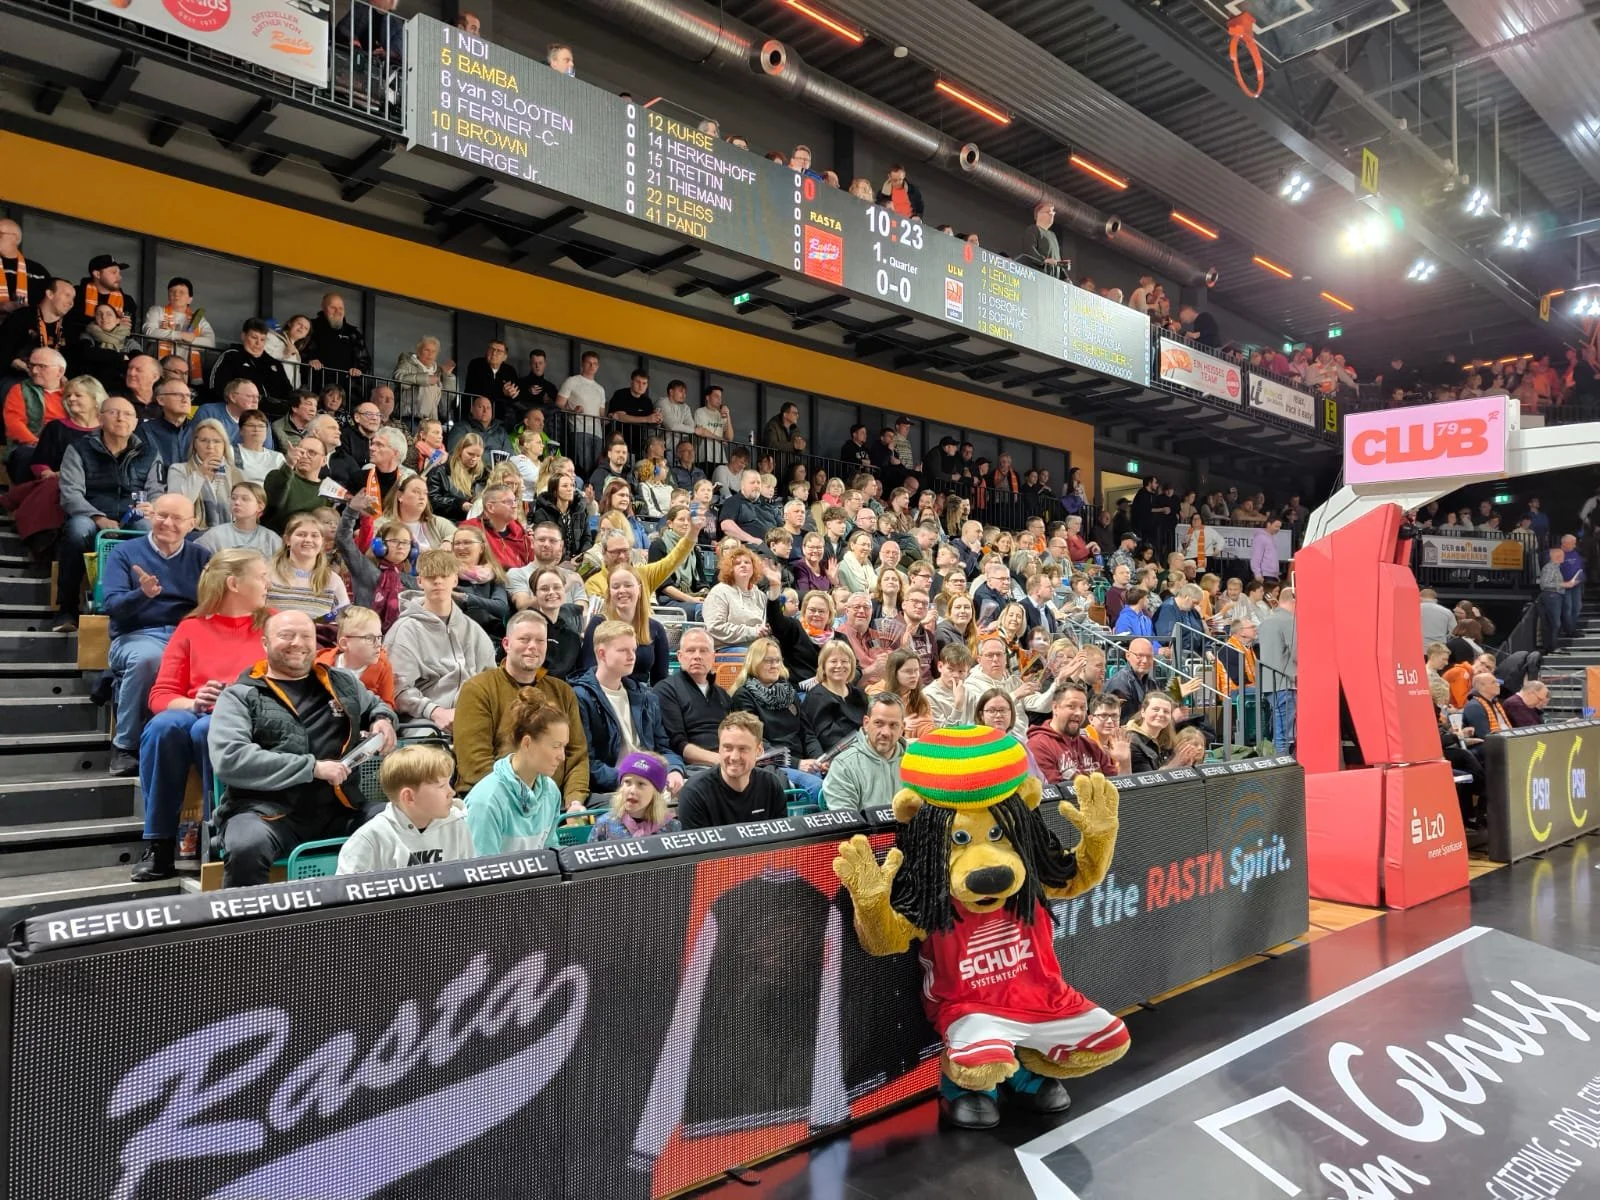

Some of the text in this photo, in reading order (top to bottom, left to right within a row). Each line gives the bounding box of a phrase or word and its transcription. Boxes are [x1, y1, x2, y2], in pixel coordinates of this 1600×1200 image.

[443, 28, 489, 60] 1 NDI
[440, 48, 519, 93] 5 BAMBA
[456, 79, 487, 101] van
[491, 90, 573, 135] SLOOTEN
[457, 98, 531, 138] FERNER
[431, 110, 528, 158] 10 BROWN
[647, 113, 714, 151] 12 KUHSE
[431, 132, 449, 151] 11
[456, 139, 519, 179] VERGE
[648, 132, 757, 185] 14 HERKENHOFF
[648, 151, 723, 192] 15 TRETTIN
[646, 188, 714, 224] 22 PLEISS
[647, 169, 732, 213] 21 THIEMANN
[646, 207, 706, 239] 41 PANDI
[810, 211, 842, 232] RASTA
[865, 206, 924, 250] 10:23
[876, 269, 911, 303] 0-0
[889, 256, 919, 276] Quarter
[1352, 418, 1488, 466] CLUB
[1436, 423, 1459, 437] 79
[1424, 813, 1445, 840] LzO
[407, 849, 443, 867] NIKE
[1090, 873, 1139, 928] the
[1146, 849, 1224, 912] RASTA
[1229, 834, 1291, 893] Spirit.
[107, 952, 589, 1200] Rasta
